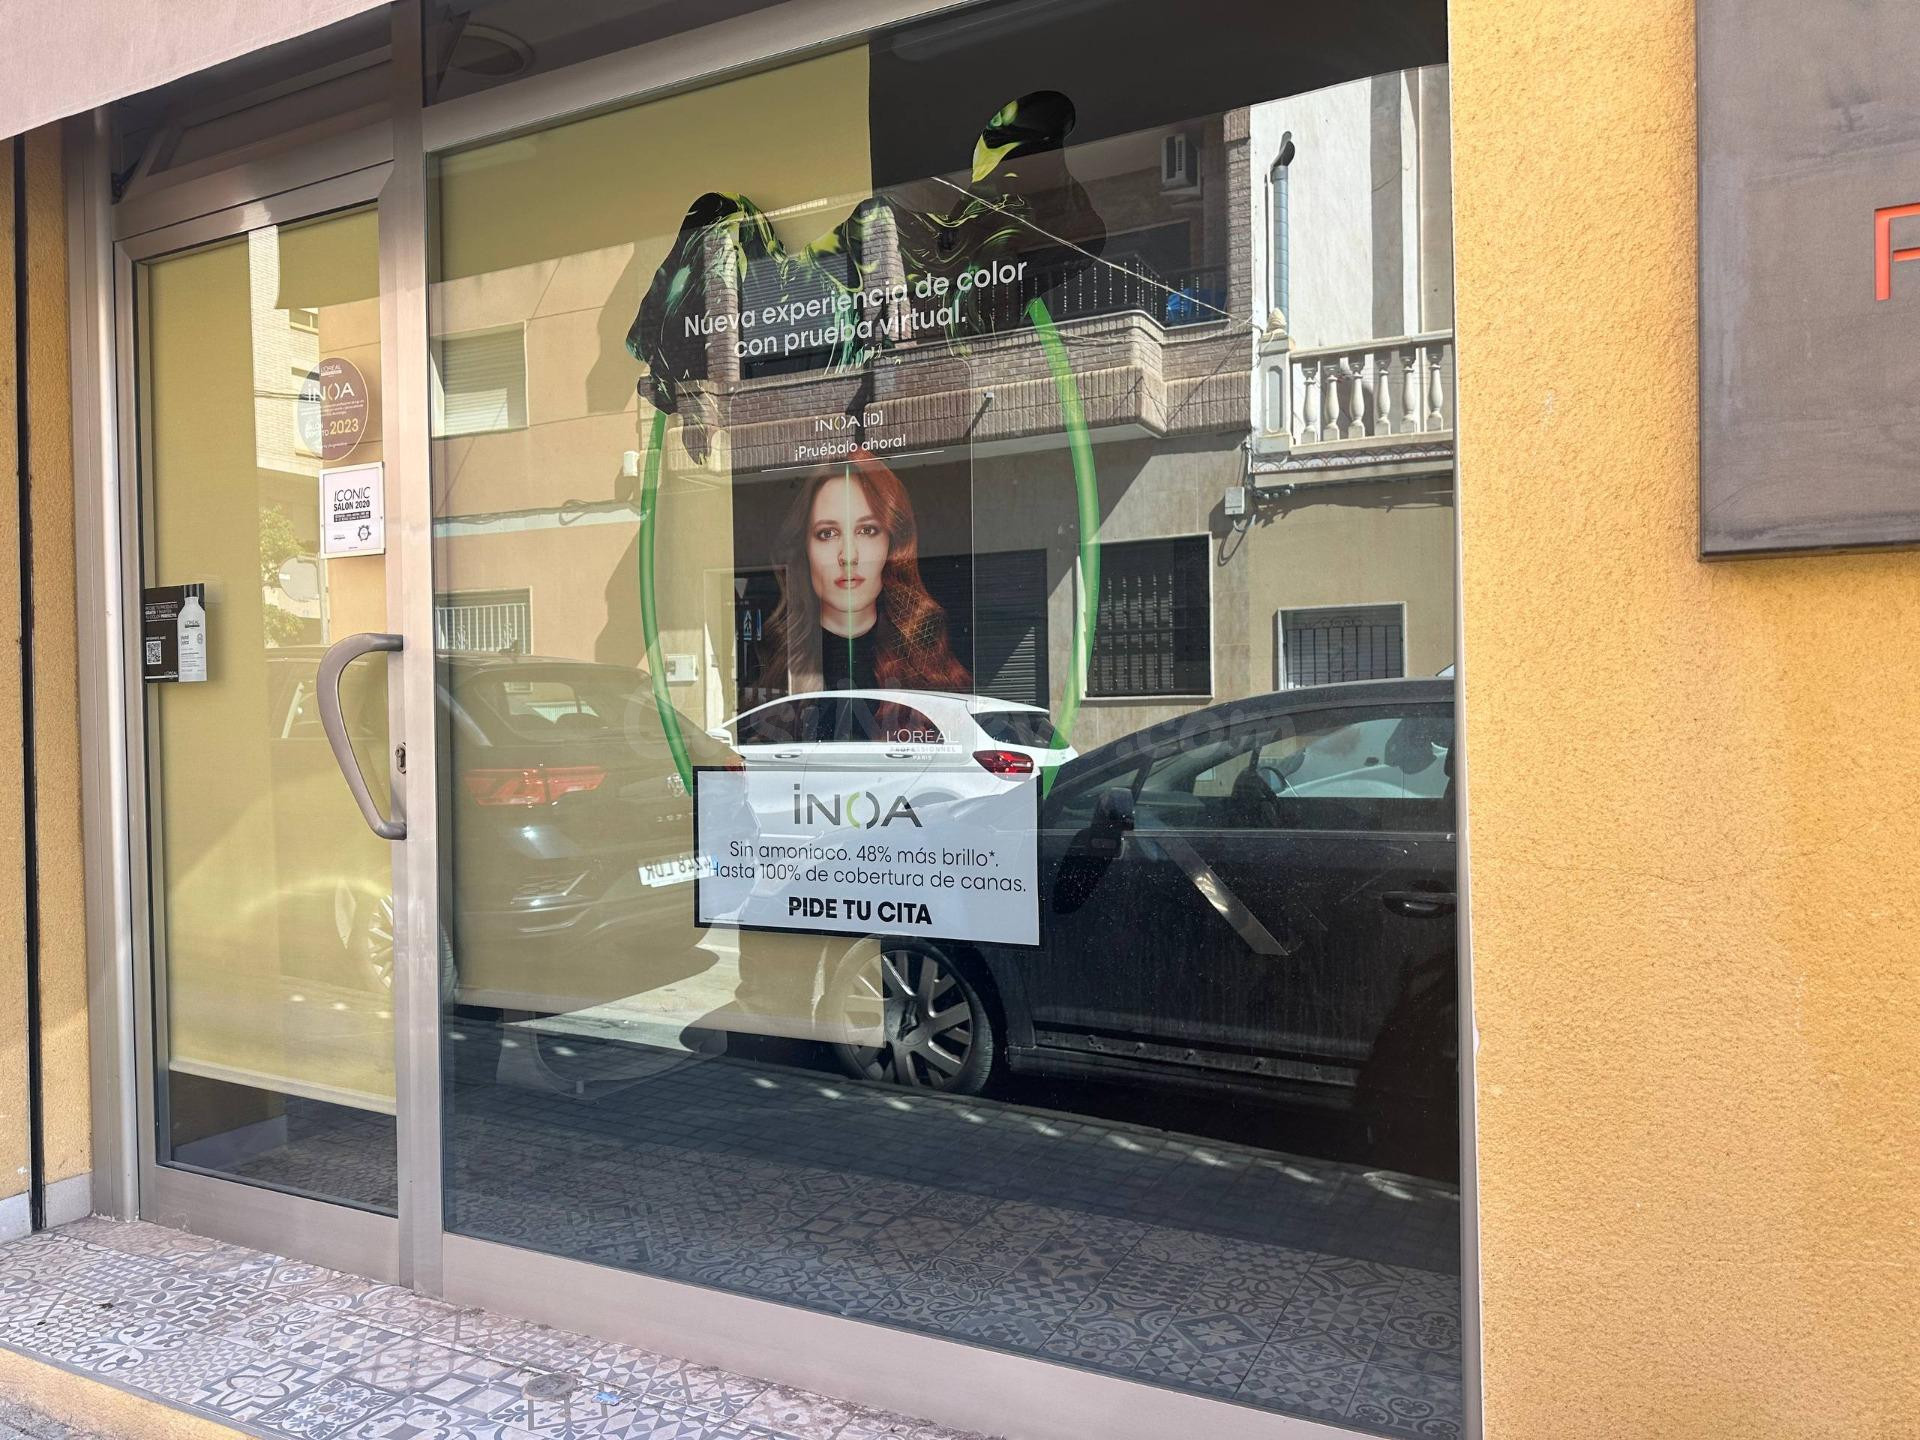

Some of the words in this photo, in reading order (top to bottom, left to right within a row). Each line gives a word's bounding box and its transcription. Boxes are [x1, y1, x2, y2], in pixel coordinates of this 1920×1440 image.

[684, 308, 756, 338] Nueva
[762, 280, 908, 326] experiencia
[915, 272, 950, 299] de
[956, 260, 1028, 292] color
[734, 335, 778, 358] con
[784, 318, 873, 356] prueba
[879, 298, 967, 336] virtual.
[330, 418, 359, 435] 2023
[794, 440, 858, 461] ¡Pruébalo
[861, 434, 906, 451] ahora!
[333, 501, 354, 511] SALON
[355, 499, 370, 509] 2020
[334, 486, 371, 502] ICONIC
[886, 728, 960, 744] L'ORÉAL
[730, 840, 754, 858] Sin
[759, 843, 852, 862] amoniaco.
[856, 845, 892, 863] 48%
[897, 847, 937, 865] más
[709, 861, 755, 879] Hasta
[760, 863, 801, 881] 100%
[805, 865, 828, 882] de
[834, 866, 924, 887] cobertura
[930, 870, 955, 888] de
[961, 875, 1027, 892] canas.
[788, 896, 838, 919] PIDE
[843, 899, 872, 921] TU
[877, 901, 933, 925] CITA
